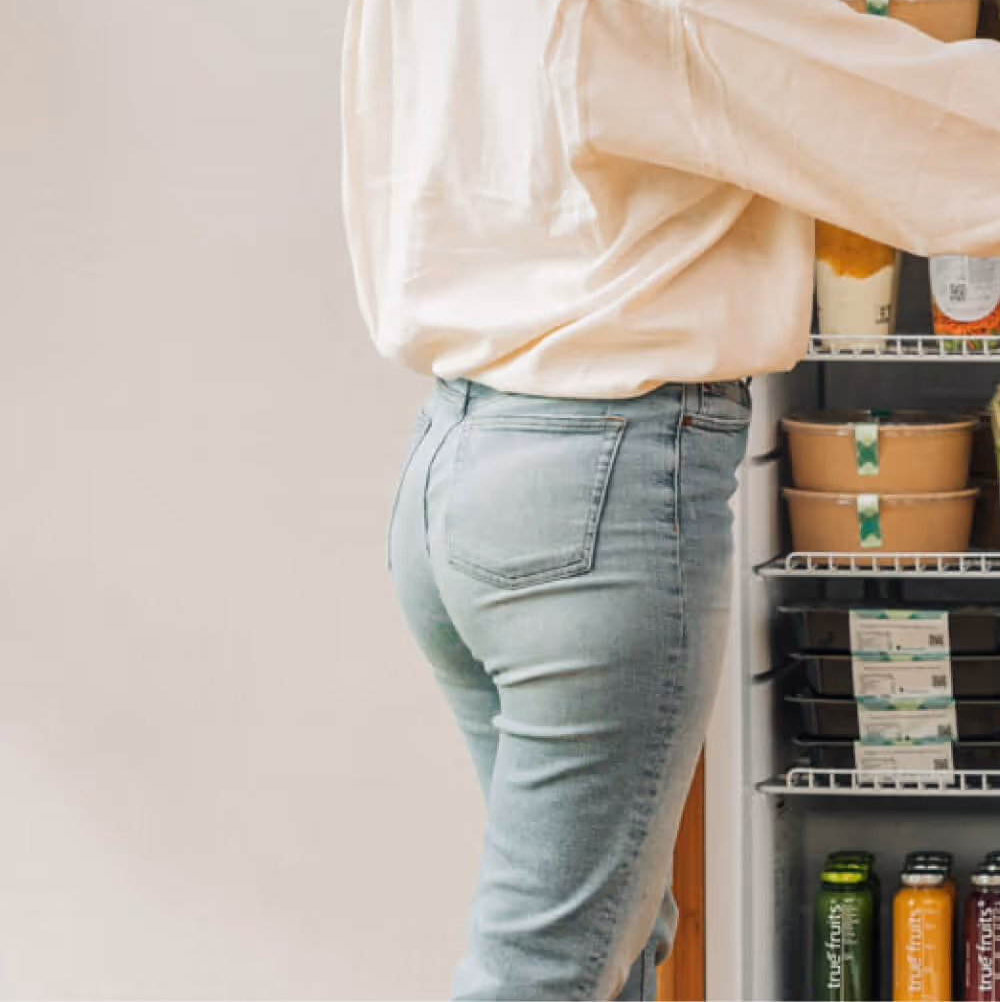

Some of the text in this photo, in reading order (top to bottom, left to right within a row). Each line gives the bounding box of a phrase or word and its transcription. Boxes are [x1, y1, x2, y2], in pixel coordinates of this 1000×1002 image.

[824, 904, 841, 949] fruits
[976, 907, 993, 991] true fruits
